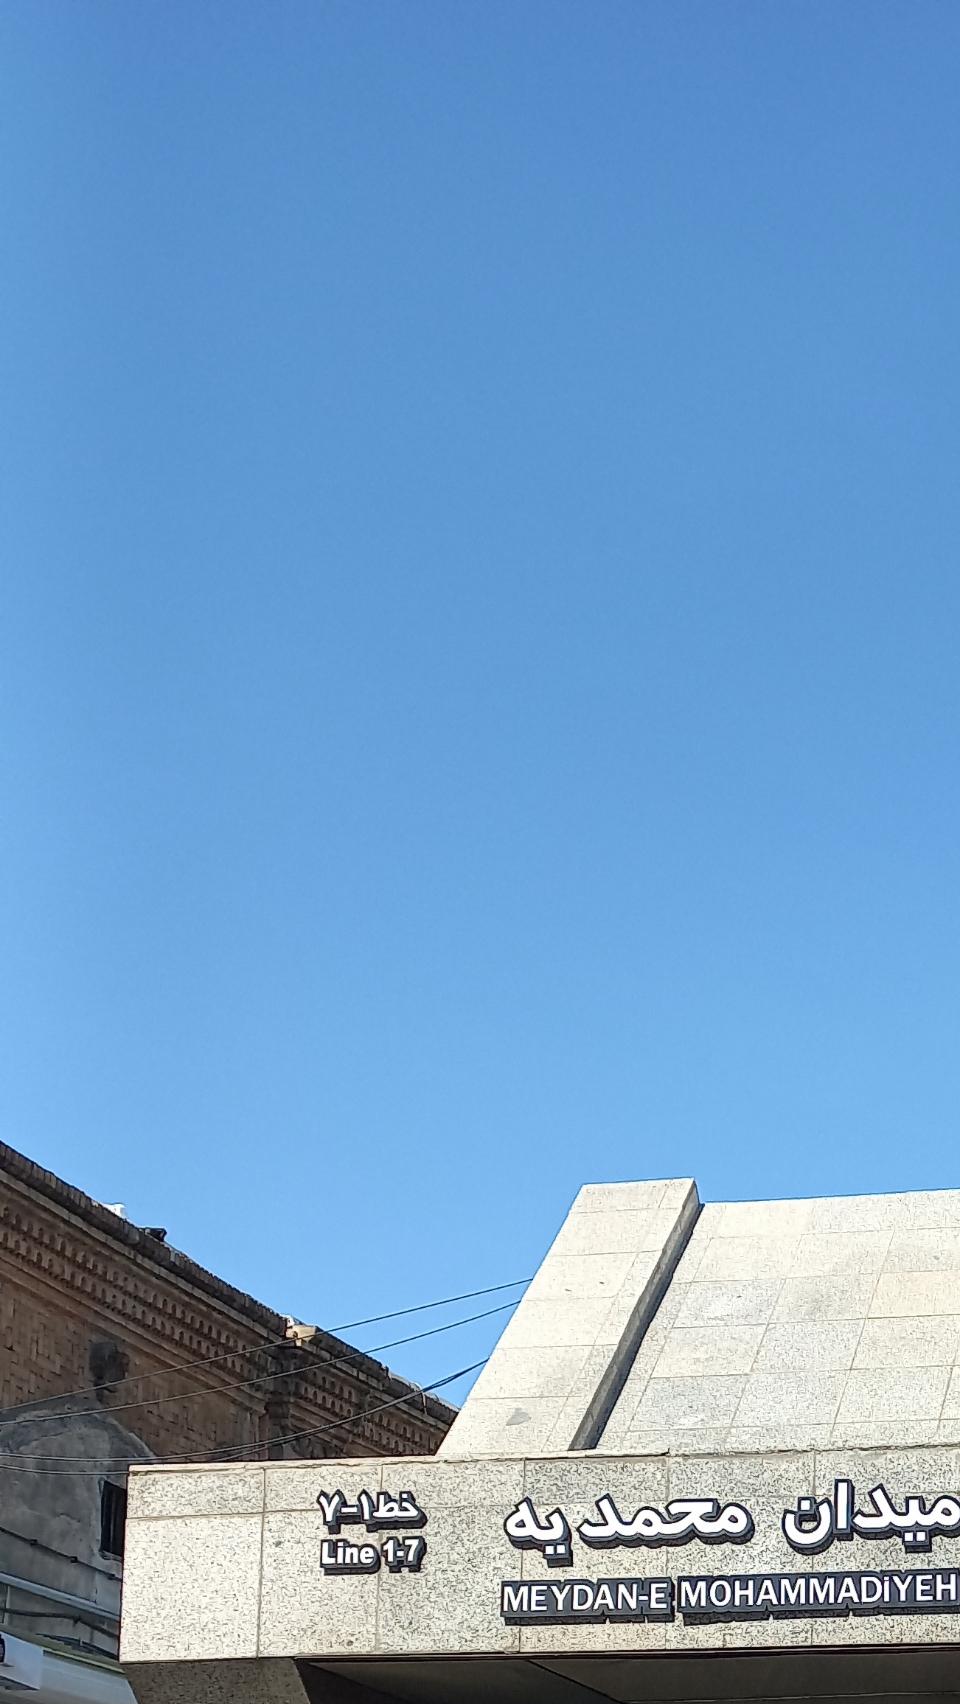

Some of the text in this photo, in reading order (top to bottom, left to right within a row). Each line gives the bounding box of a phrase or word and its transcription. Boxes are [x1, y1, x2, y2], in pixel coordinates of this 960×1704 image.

[321, 1537, 422, 1565] Line 1-7
[502, 1581, 669, 1613] MEYDAN-E
